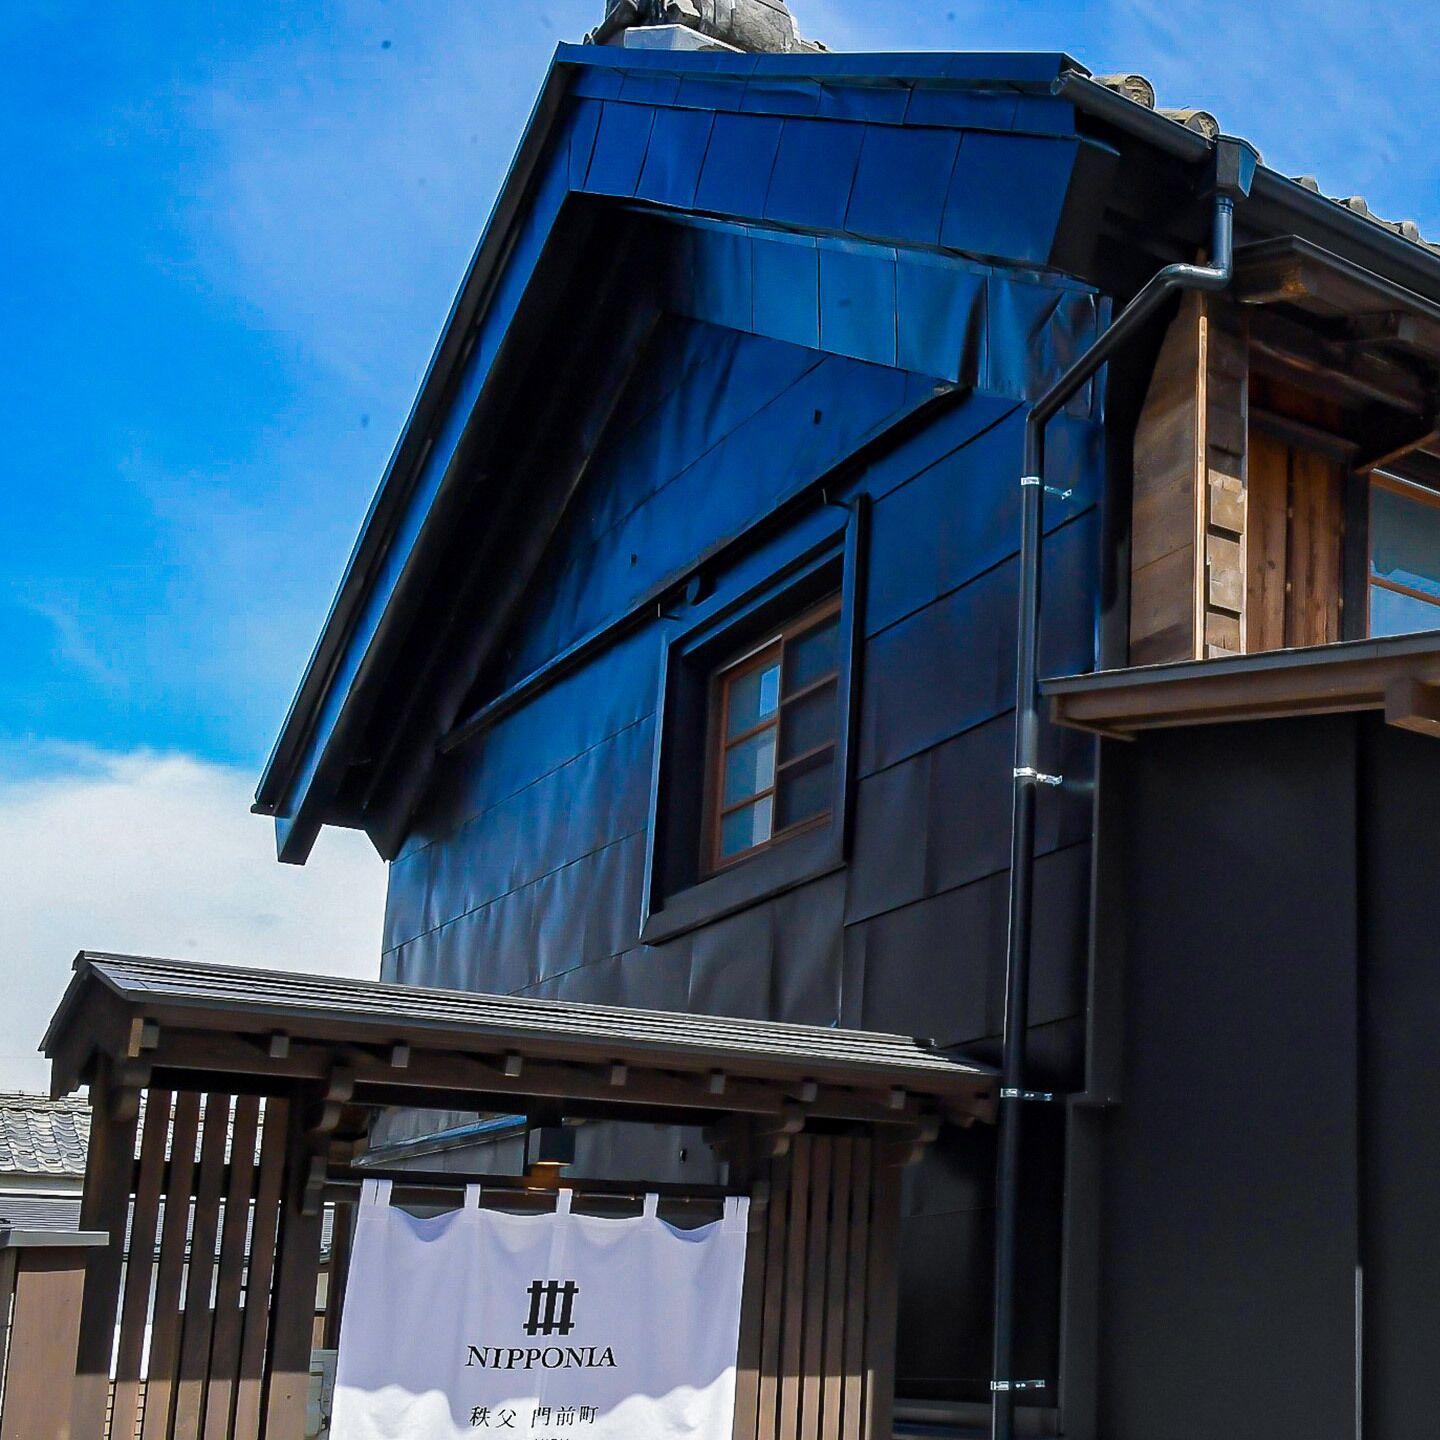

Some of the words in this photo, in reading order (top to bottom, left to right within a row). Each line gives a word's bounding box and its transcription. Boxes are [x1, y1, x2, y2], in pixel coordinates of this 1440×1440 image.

[465, 1345, 618, 1369] NIPPONIA
[469, 1406, 517, 1429] 秩父
[531, 1405, 599, 1429] 門前町
